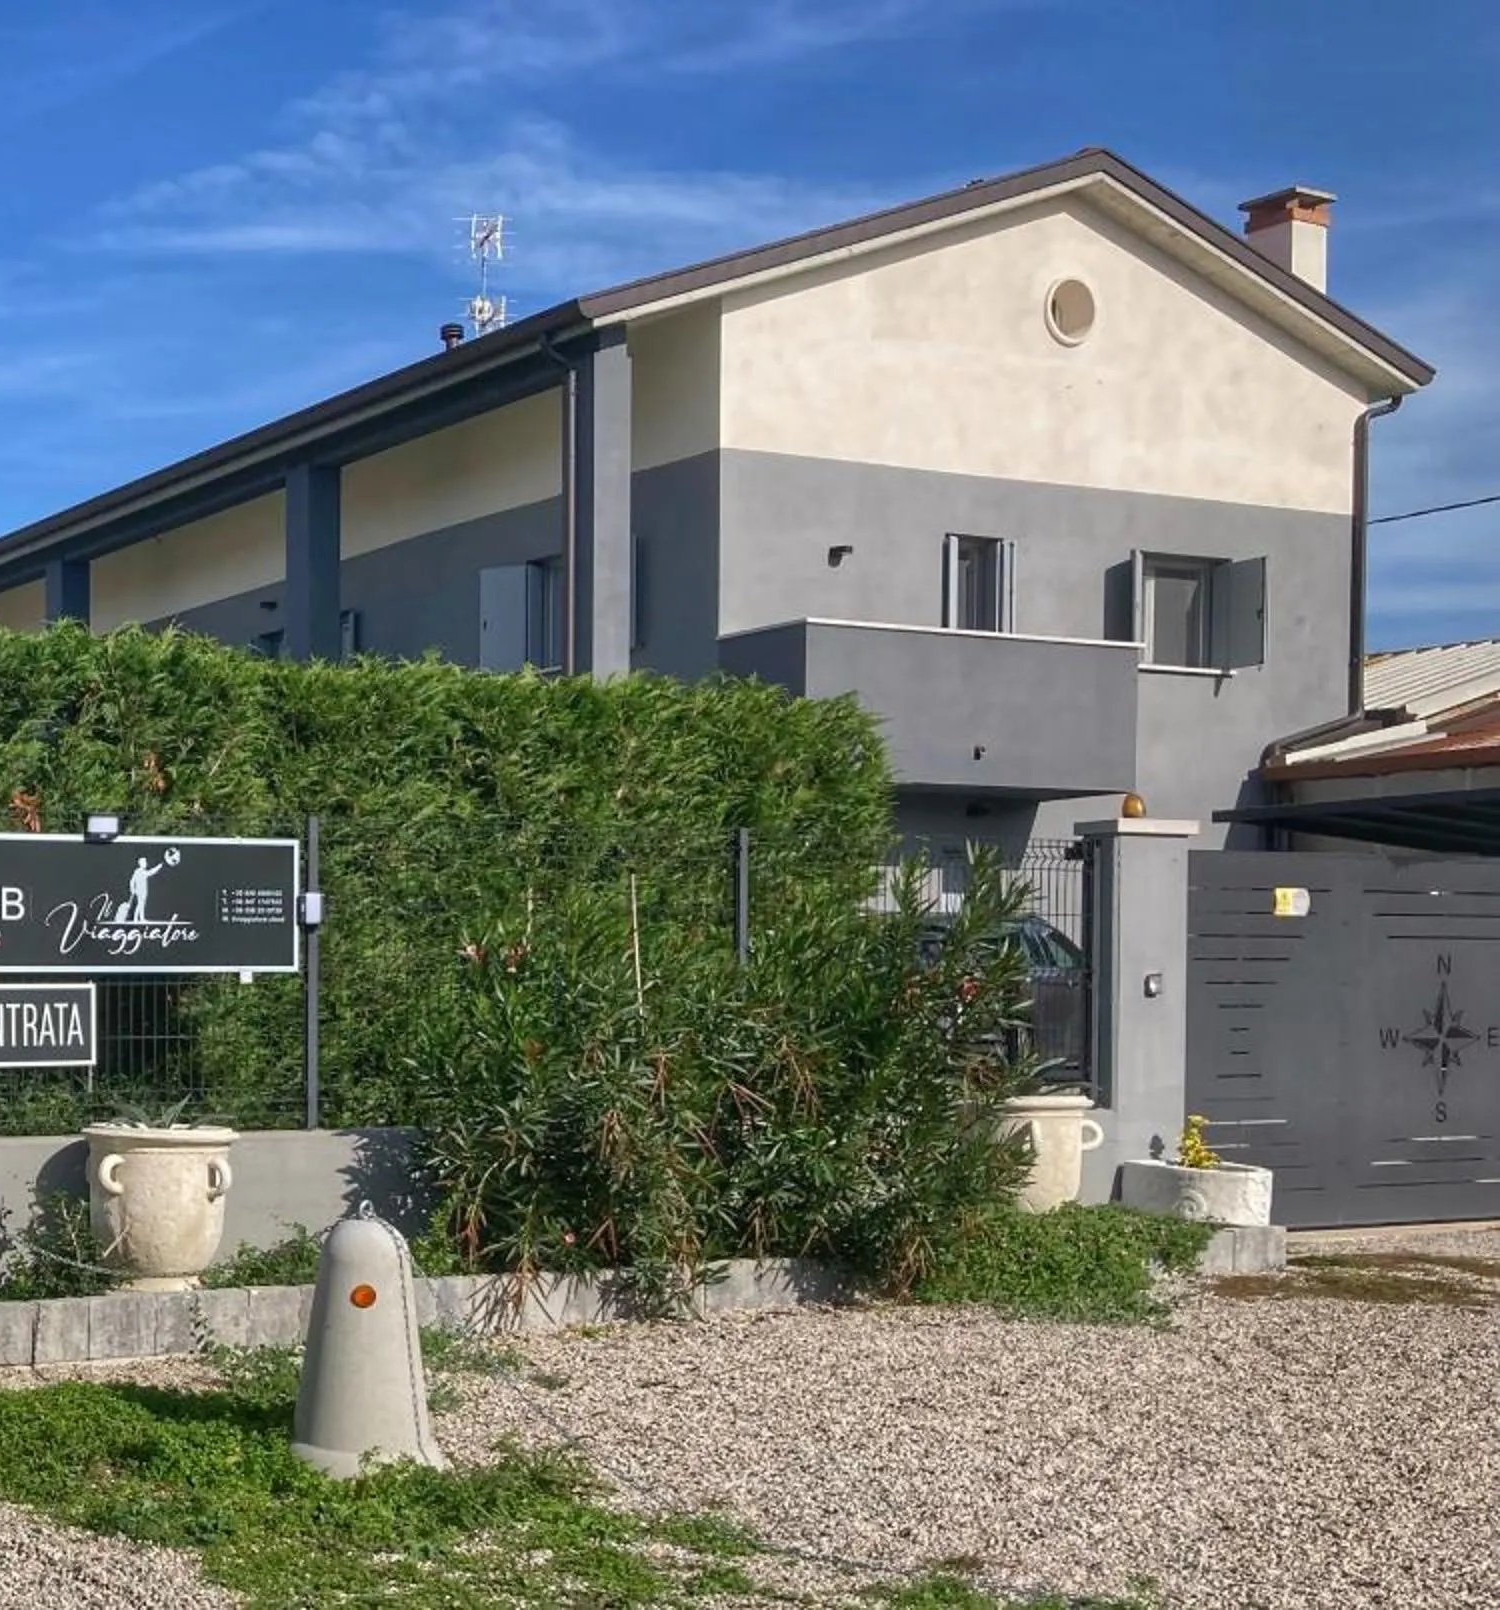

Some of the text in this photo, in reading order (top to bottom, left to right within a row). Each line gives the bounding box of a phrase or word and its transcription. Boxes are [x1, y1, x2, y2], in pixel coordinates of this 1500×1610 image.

[44, 901, 199, 955] Viaggiatore
[1437, 954, 1452, 976] N
[1379, 1026, 1500, 1049] W E
[1435, 1102, 1448, 1124] S
